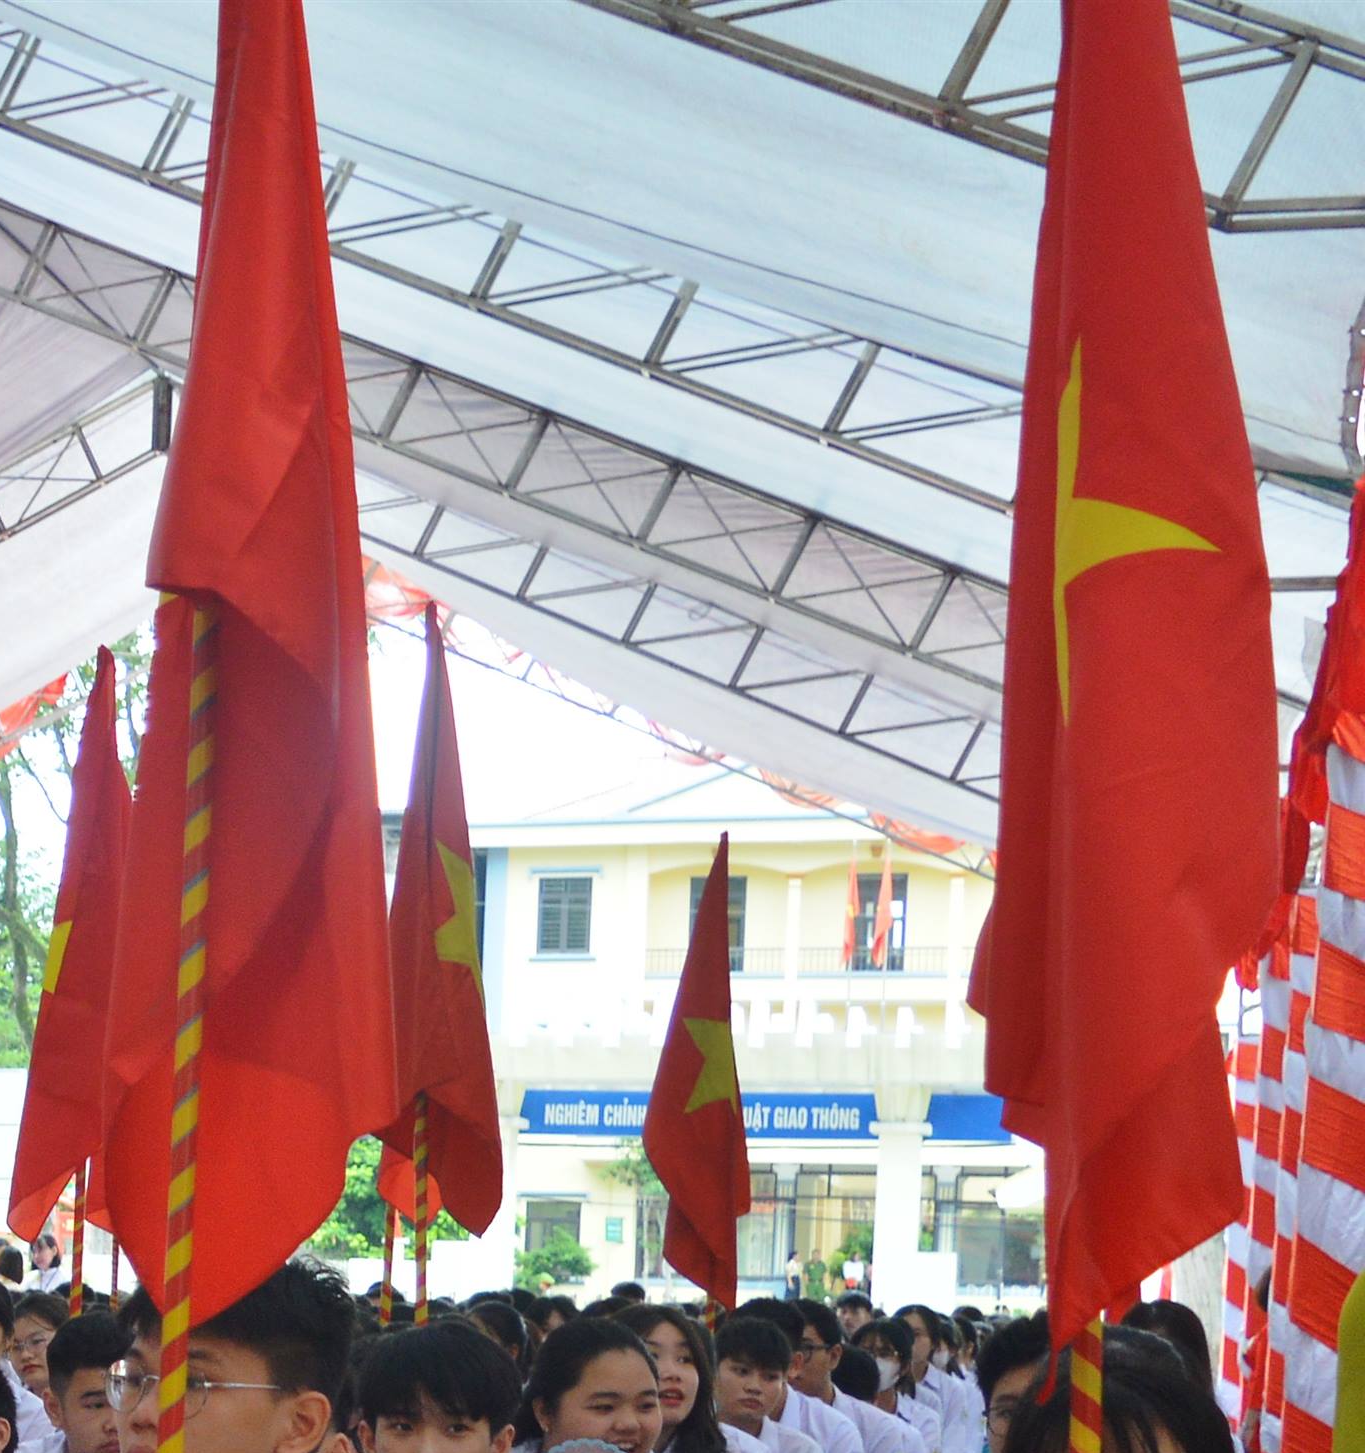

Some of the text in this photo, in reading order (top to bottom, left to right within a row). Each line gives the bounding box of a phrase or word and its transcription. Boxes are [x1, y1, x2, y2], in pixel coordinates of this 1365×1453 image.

[544, 1100, 600, 1126] NGHIÊM
[742, 1102, 771, 1133] UẬT
[773, 1106, 808, 1130] GIAO
[810, 1102, 860, 1131] THÔNG
